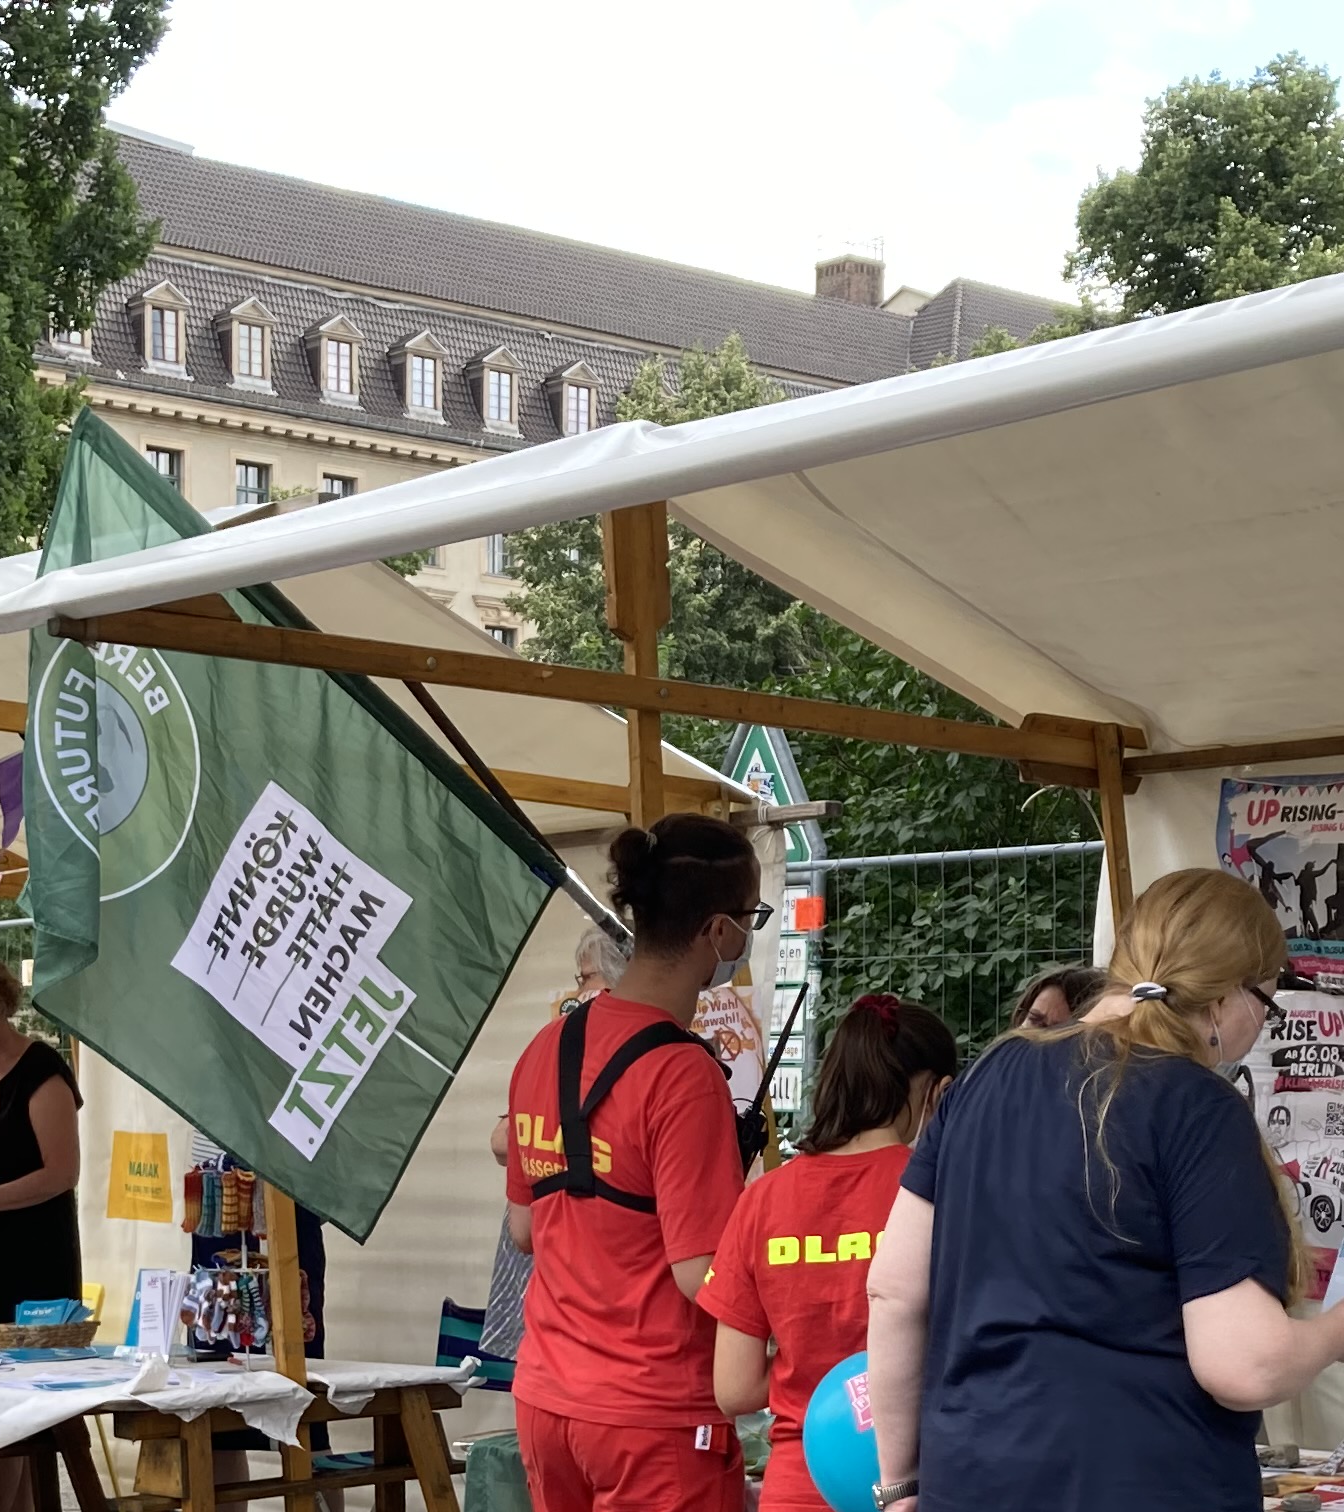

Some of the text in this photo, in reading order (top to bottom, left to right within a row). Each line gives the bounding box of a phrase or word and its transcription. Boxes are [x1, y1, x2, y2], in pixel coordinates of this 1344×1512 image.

[710, 998, 739, 1012] Wahl
[1289, 1010, 1317, 1019] AUGUST
[1270, 1019, 1318, 1042] RISE
[1299, 1046, 1343, 1063] 16.08.
[1290, 1063, 1336, 1077] BERLIN
[515, 1113, 612, 1174] DLG
[768, 1231, 885, 1265] DLR
